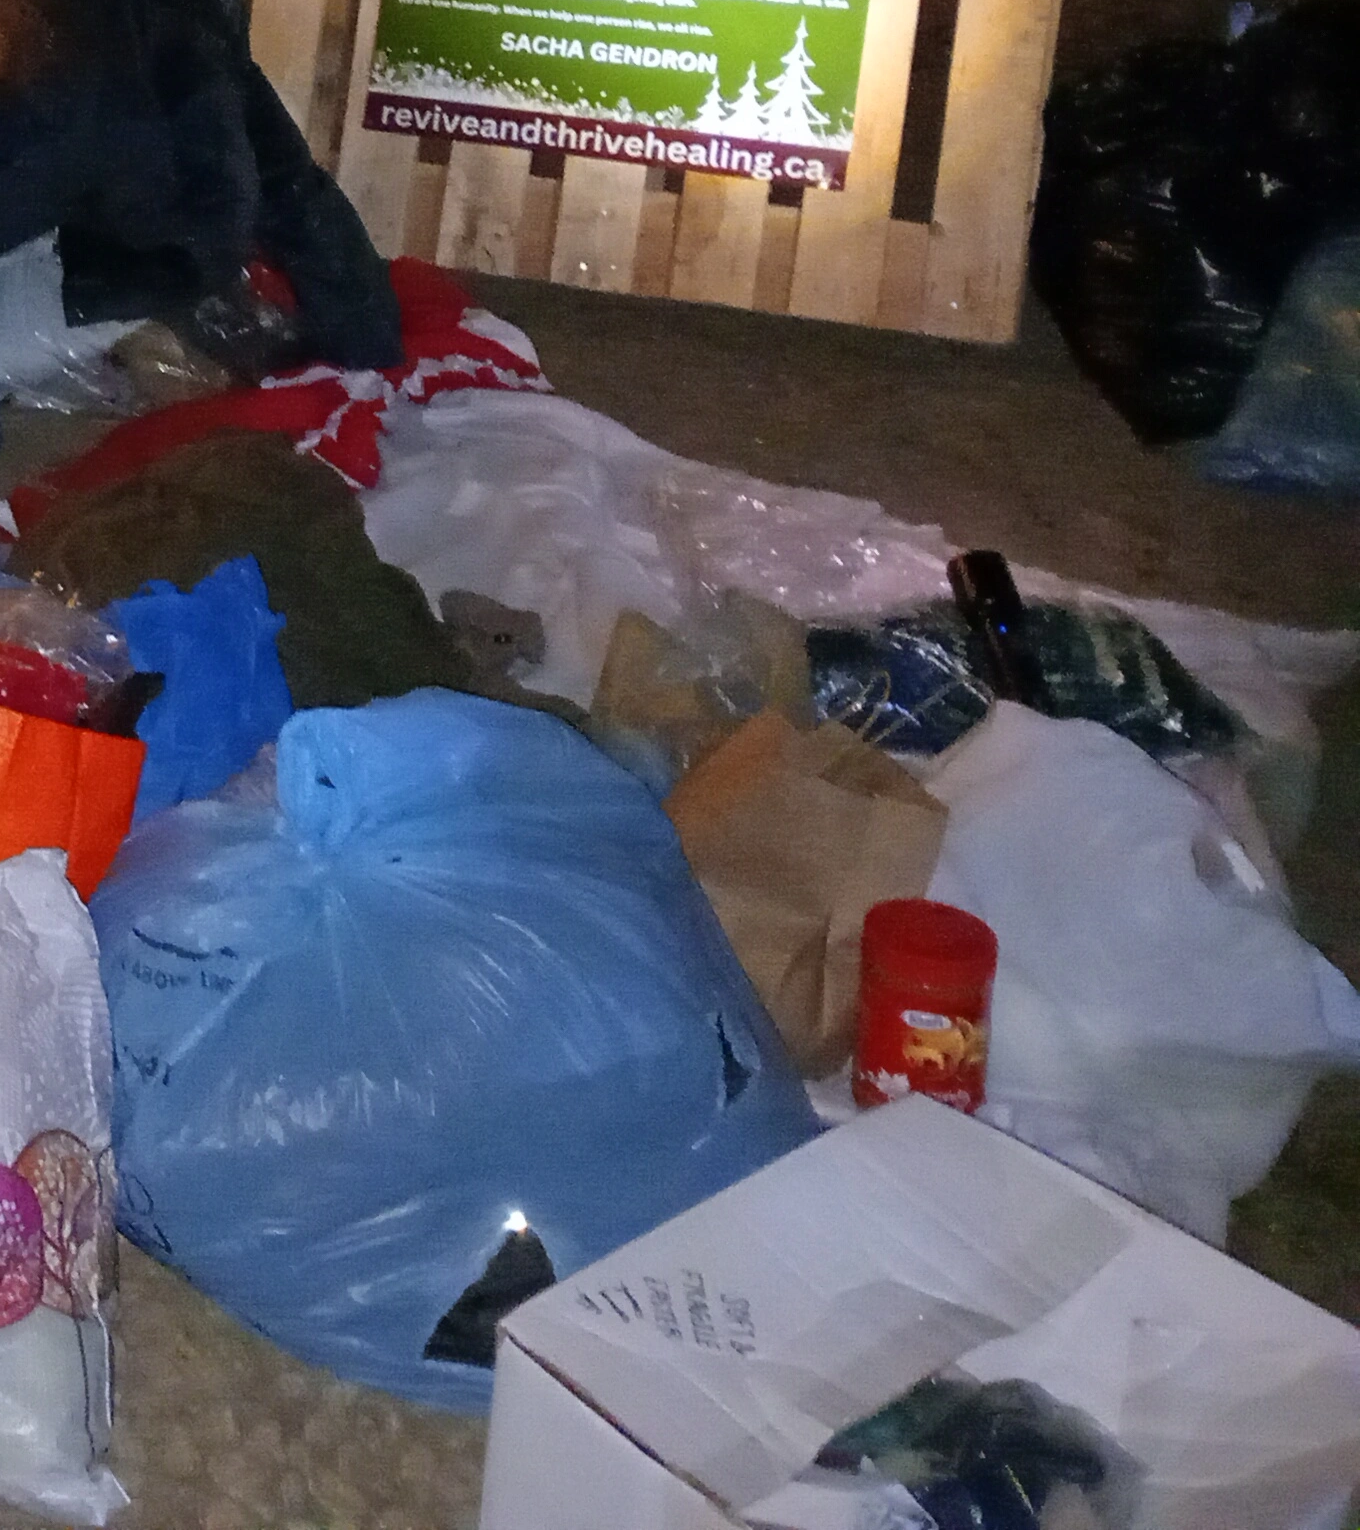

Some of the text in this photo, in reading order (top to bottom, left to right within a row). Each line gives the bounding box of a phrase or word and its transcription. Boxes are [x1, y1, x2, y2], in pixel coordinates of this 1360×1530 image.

[500, 31, 718, 74] SACHA GENDRON
[380, 102, 827, 183] reviveandthrivehealing.ca
